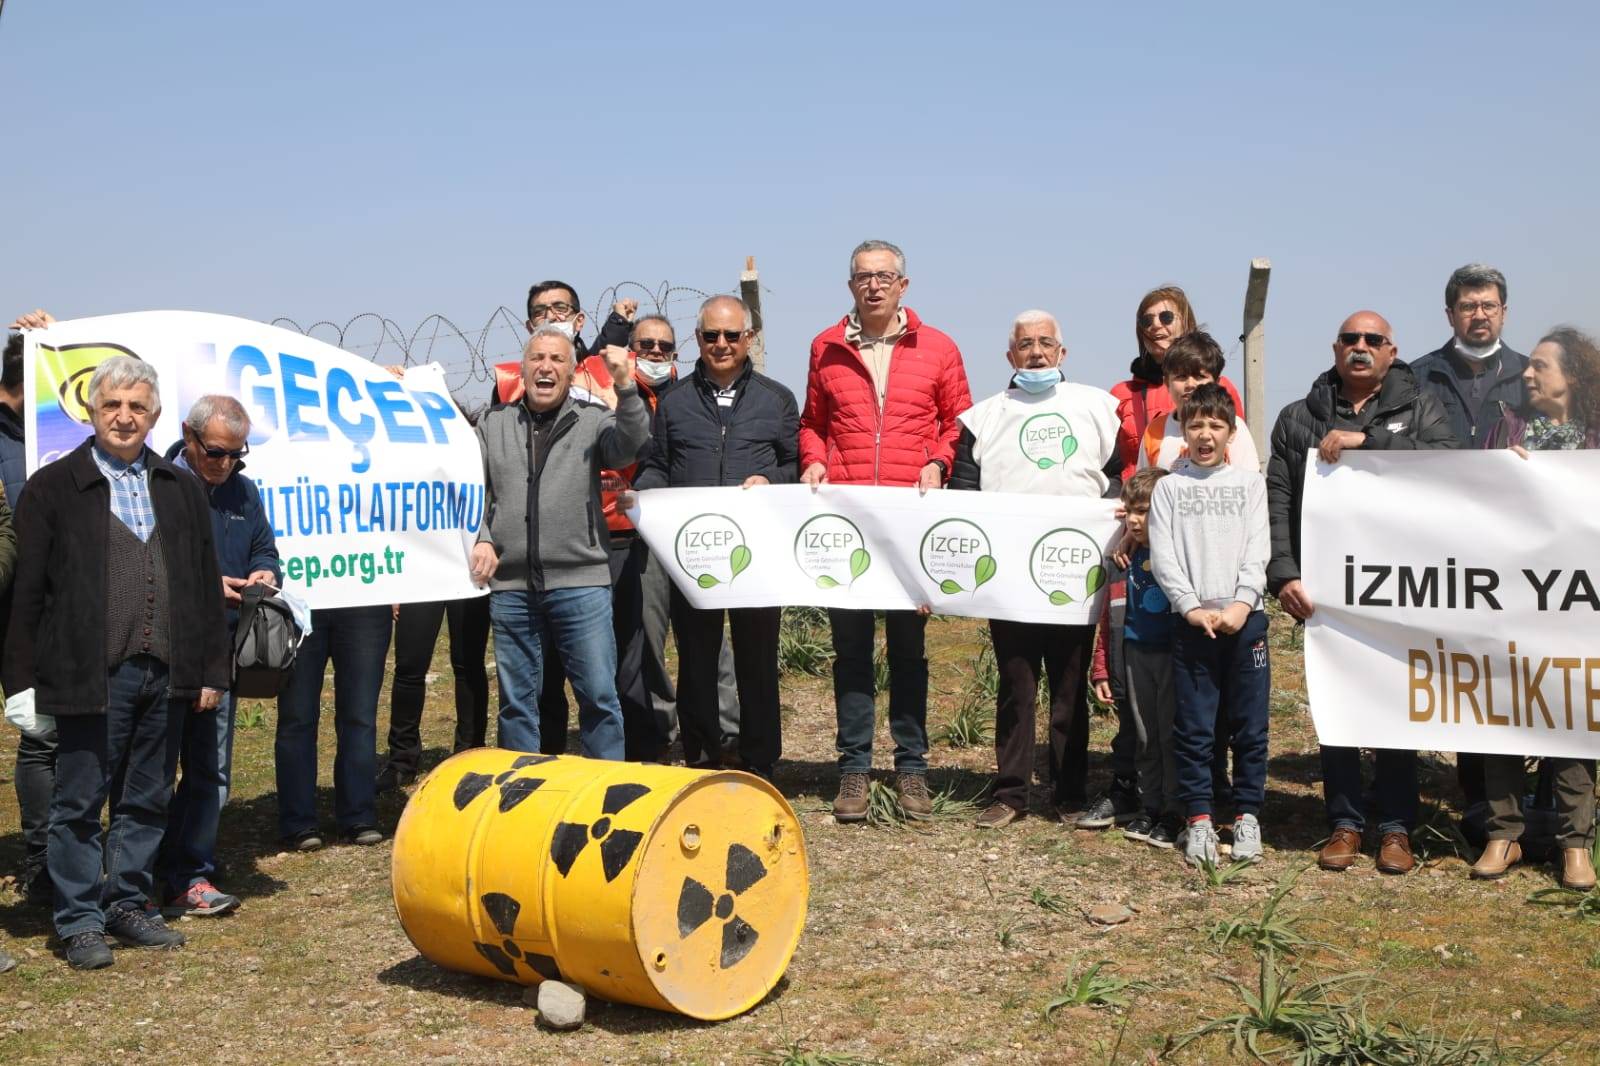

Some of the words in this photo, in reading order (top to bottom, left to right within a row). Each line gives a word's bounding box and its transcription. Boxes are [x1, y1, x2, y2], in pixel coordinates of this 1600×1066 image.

[1178, 485, 1246, 500] NEVER
[339, 481, 484, 533] PLATFORMU
[1178, 500, 1246, 516] SORRY
[685, 530, 734, 550] İZÇEP
[804, 530, 853, 552] İZÇEP
[930, 534, 980, 557] İZÇEP
[1041, 543, 1092, 567] İZÇEP
[1345, 555, 1503, 611] İZMİR
[1521, 569, 1600, 611] YA
